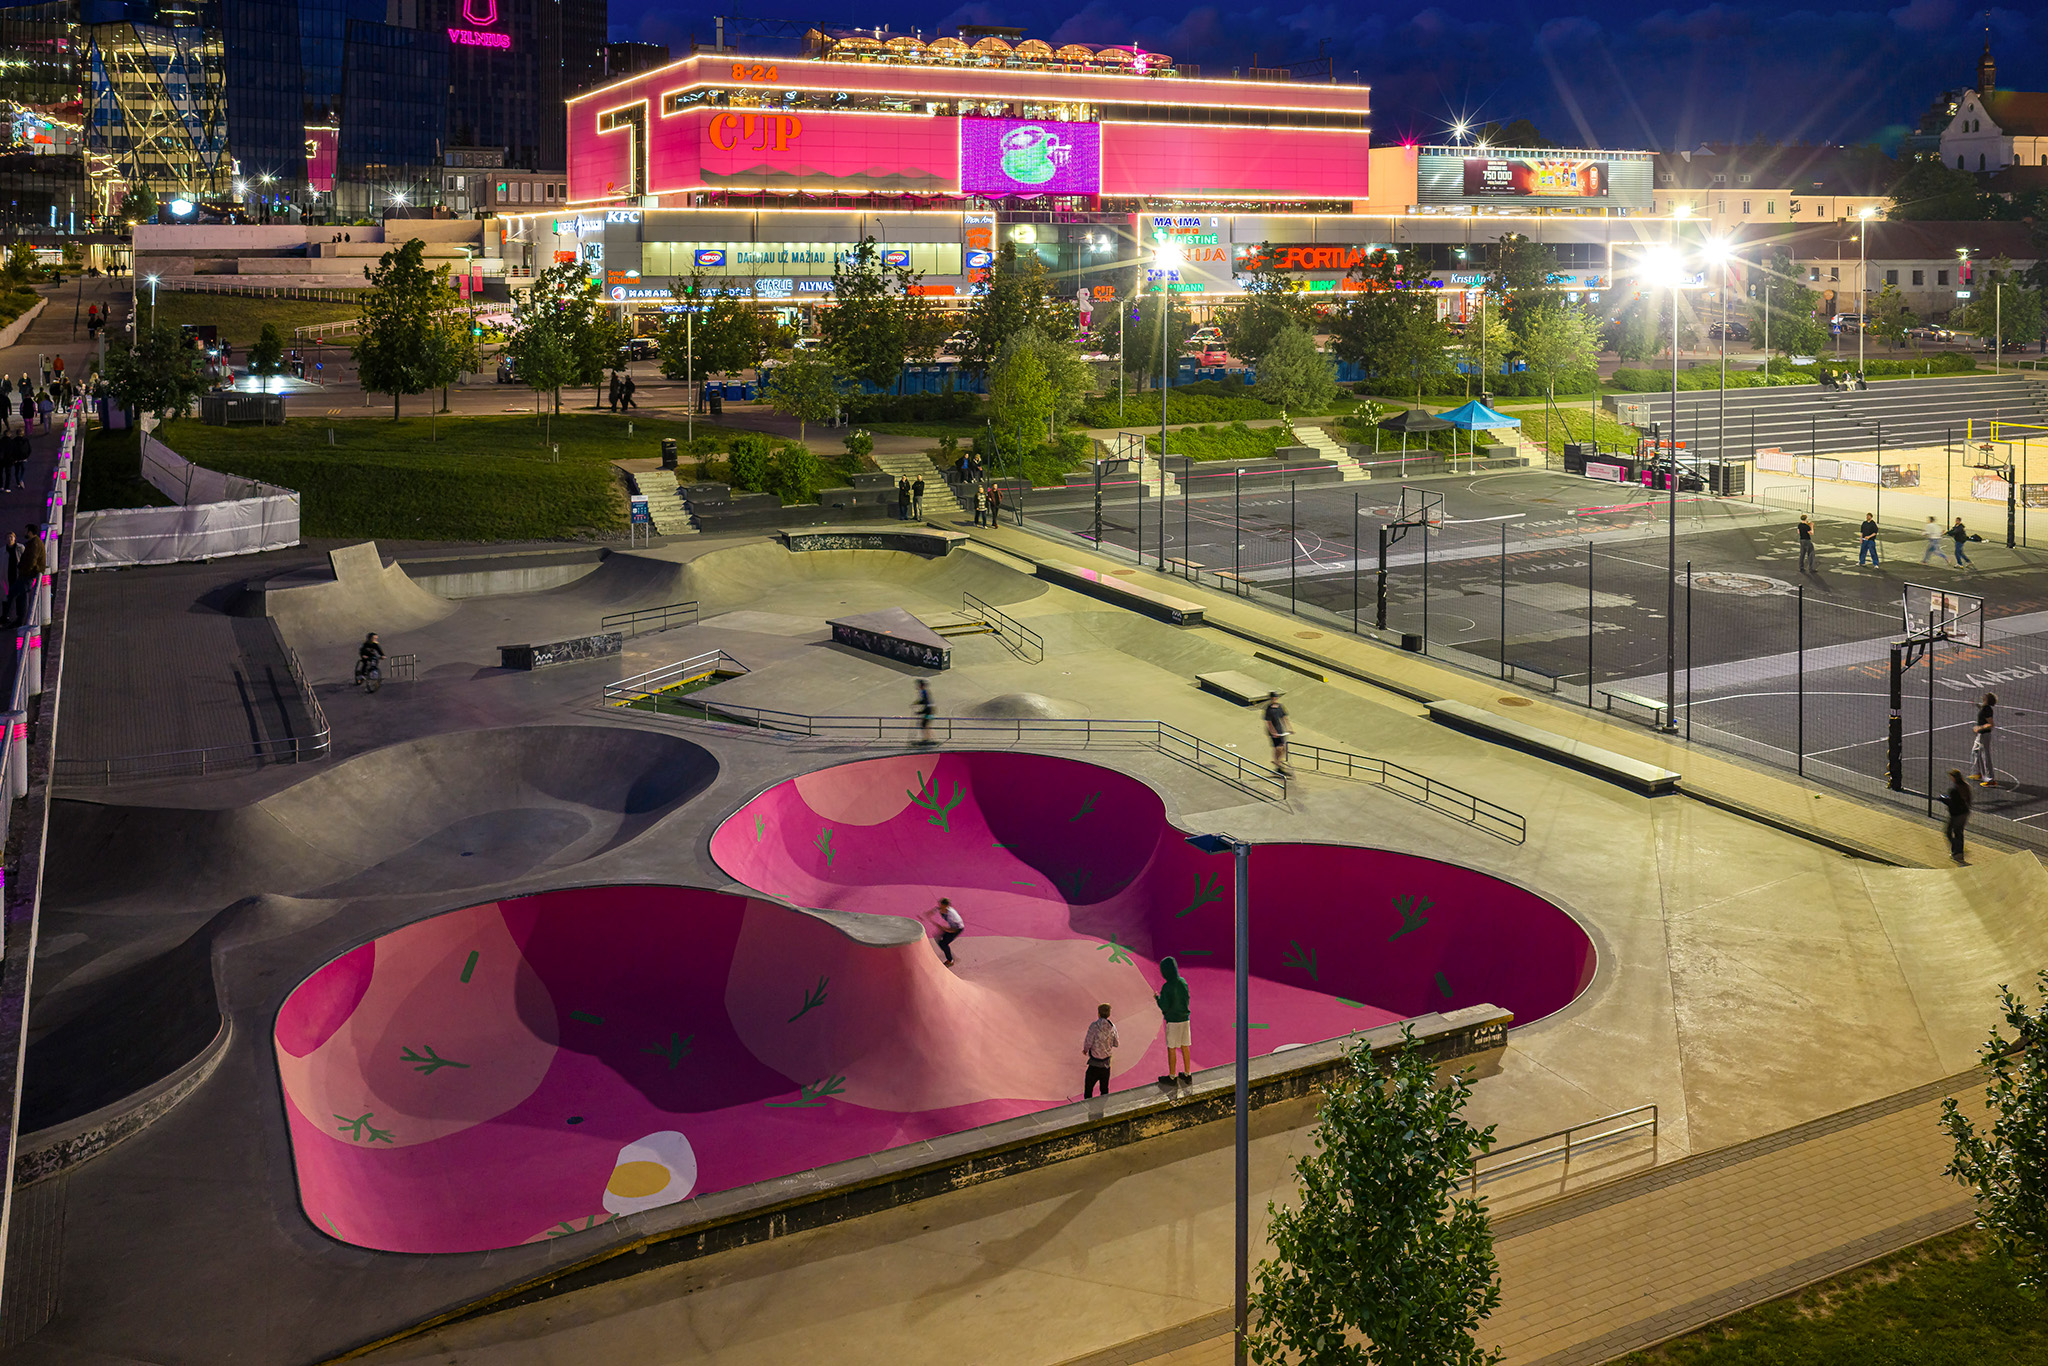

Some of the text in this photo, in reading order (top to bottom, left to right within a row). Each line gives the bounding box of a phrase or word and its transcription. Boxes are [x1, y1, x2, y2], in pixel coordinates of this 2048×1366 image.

[447, 27, 512, 49] VILNIUS
[731, 63, 779, 82] 8-24
[708, 112, 802, 151] CUP
[605, 211, 640, 223] KFC
[1154, 217, 1201, 229] MAXIMA
